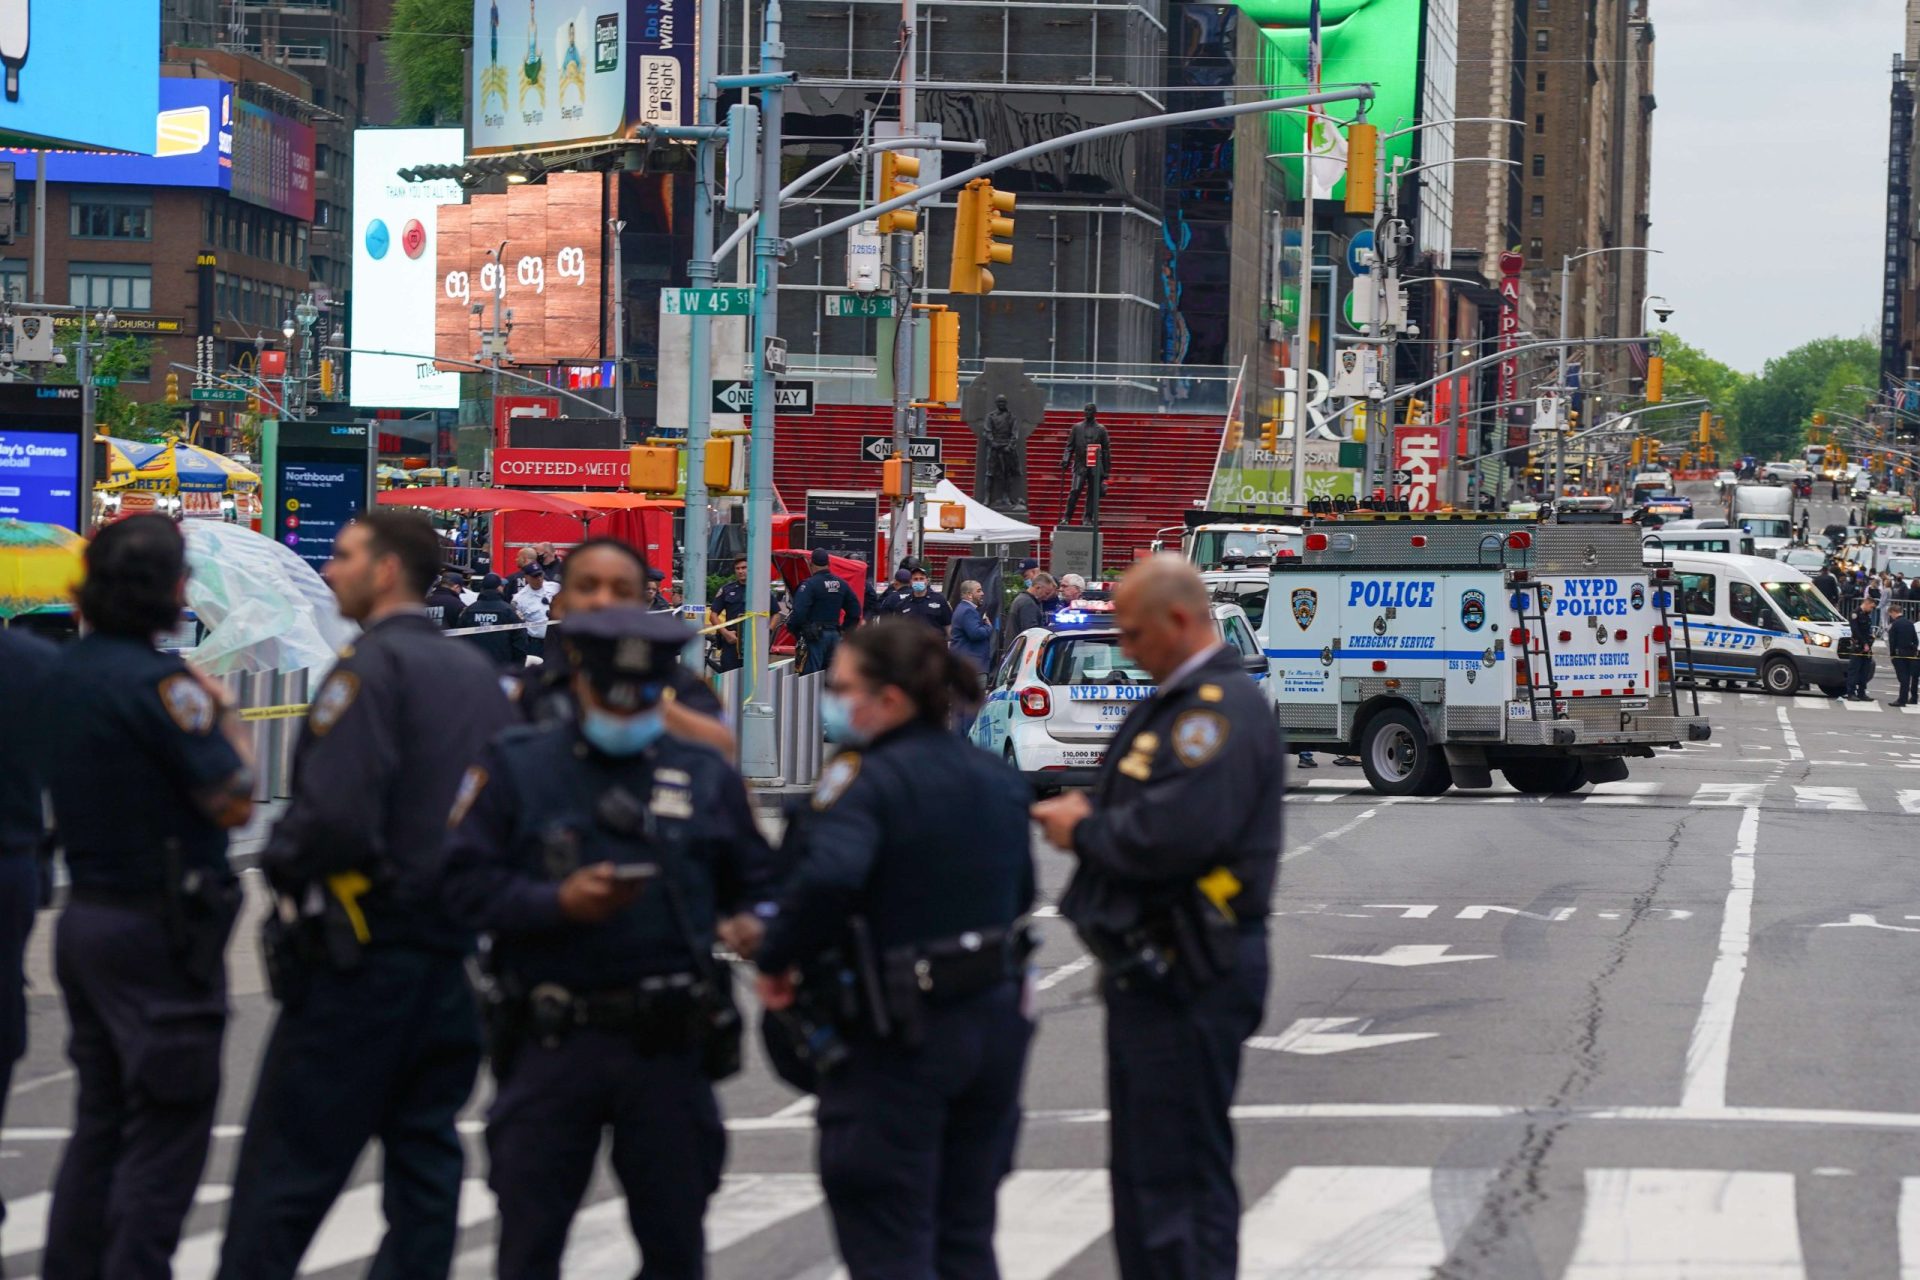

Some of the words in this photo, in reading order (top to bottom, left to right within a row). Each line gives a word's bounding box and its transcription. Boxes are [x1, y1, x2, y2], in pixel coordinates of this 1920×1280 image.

[645, 18, 659, 38] Do
[659, 15, 674, 50] With
[660, 62, 676, 100] Right
[647, 62, 660, 120] Breathe
[684, 292, 700, 311] W
[708, 292, 729, 311] 45
[737, 292, 748, 305] St
[843, 299, 854, 314] W
[861, 299, 877, 314] 45
[119, 320, 155, 329] CHURCH
[36, 387, 79, 398] LinkNYC
[331, 426, 366, 435] LinkNYC
[26, 443, 67, 457] Games
[500, 461, 577, 475] COFFEED
[585, 462, 618, 476] SWEET
[1402, 434, 1439, 511] tkts
[286, 471, 344, 482] Northbound
[1348, 581, 1435, 607] POLICE
[1565, 579, 1618, 596] NYPD
[1556, 599, 1627, 616] POLICE
[475, 613, 498, 622] NYPD
[1348, 636, 1398, 648] EMERGENCY
[1400, 636, 1435, 648] SERVICE
[1704, 631, 1756, 649] NYPD
[1554, 653, 1597, 666] EMERGENCY
[1600, 653, 1629, 666] SERVICE
[1070, 686, 1109, 699] NYPD
[1116, 686, 1157, 699] POLIC
[1102, 706, 1127, 715] 2706
